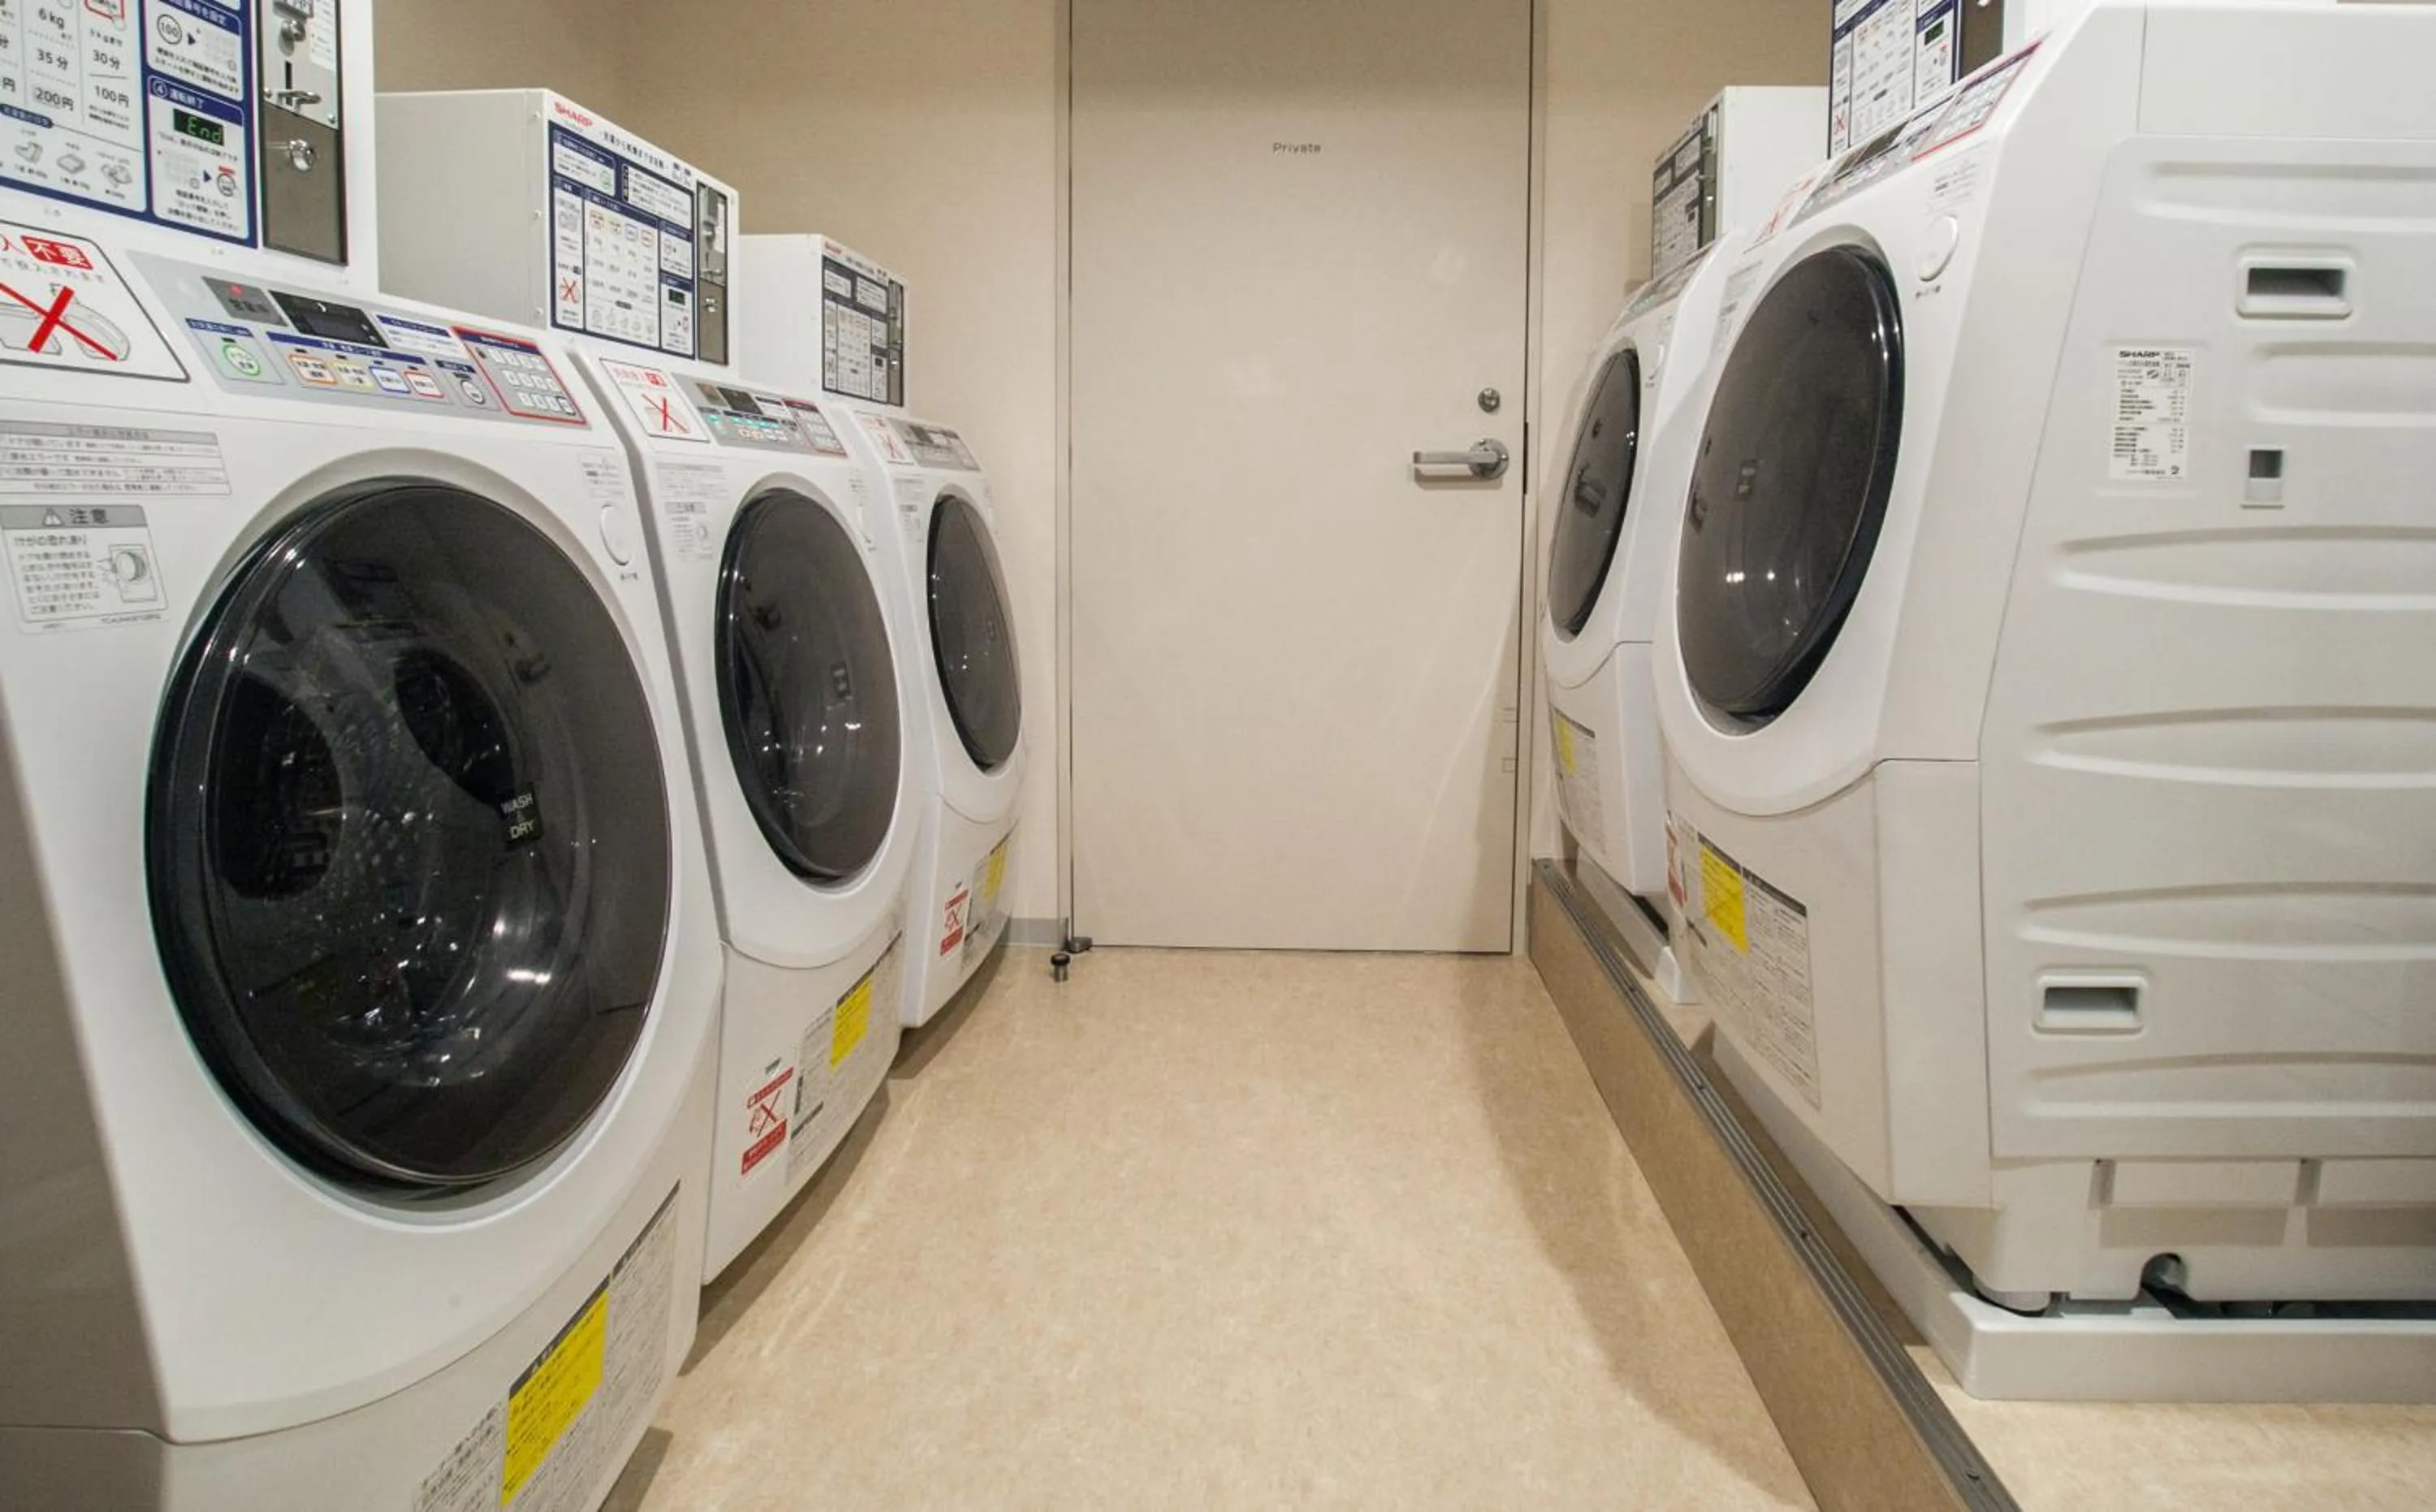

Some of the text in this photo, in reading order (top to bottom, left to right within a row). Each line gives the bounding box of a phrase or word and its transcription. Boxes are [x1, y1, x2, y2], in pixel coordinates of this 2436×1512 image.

[554, 102, 594, 128] SHARP
[186, 116, 222, 145] End
[2119, 350, 2160, 358] SHARP
[500, 792, 533, 814] WASH
[510, 819, 533, 840] DRY
